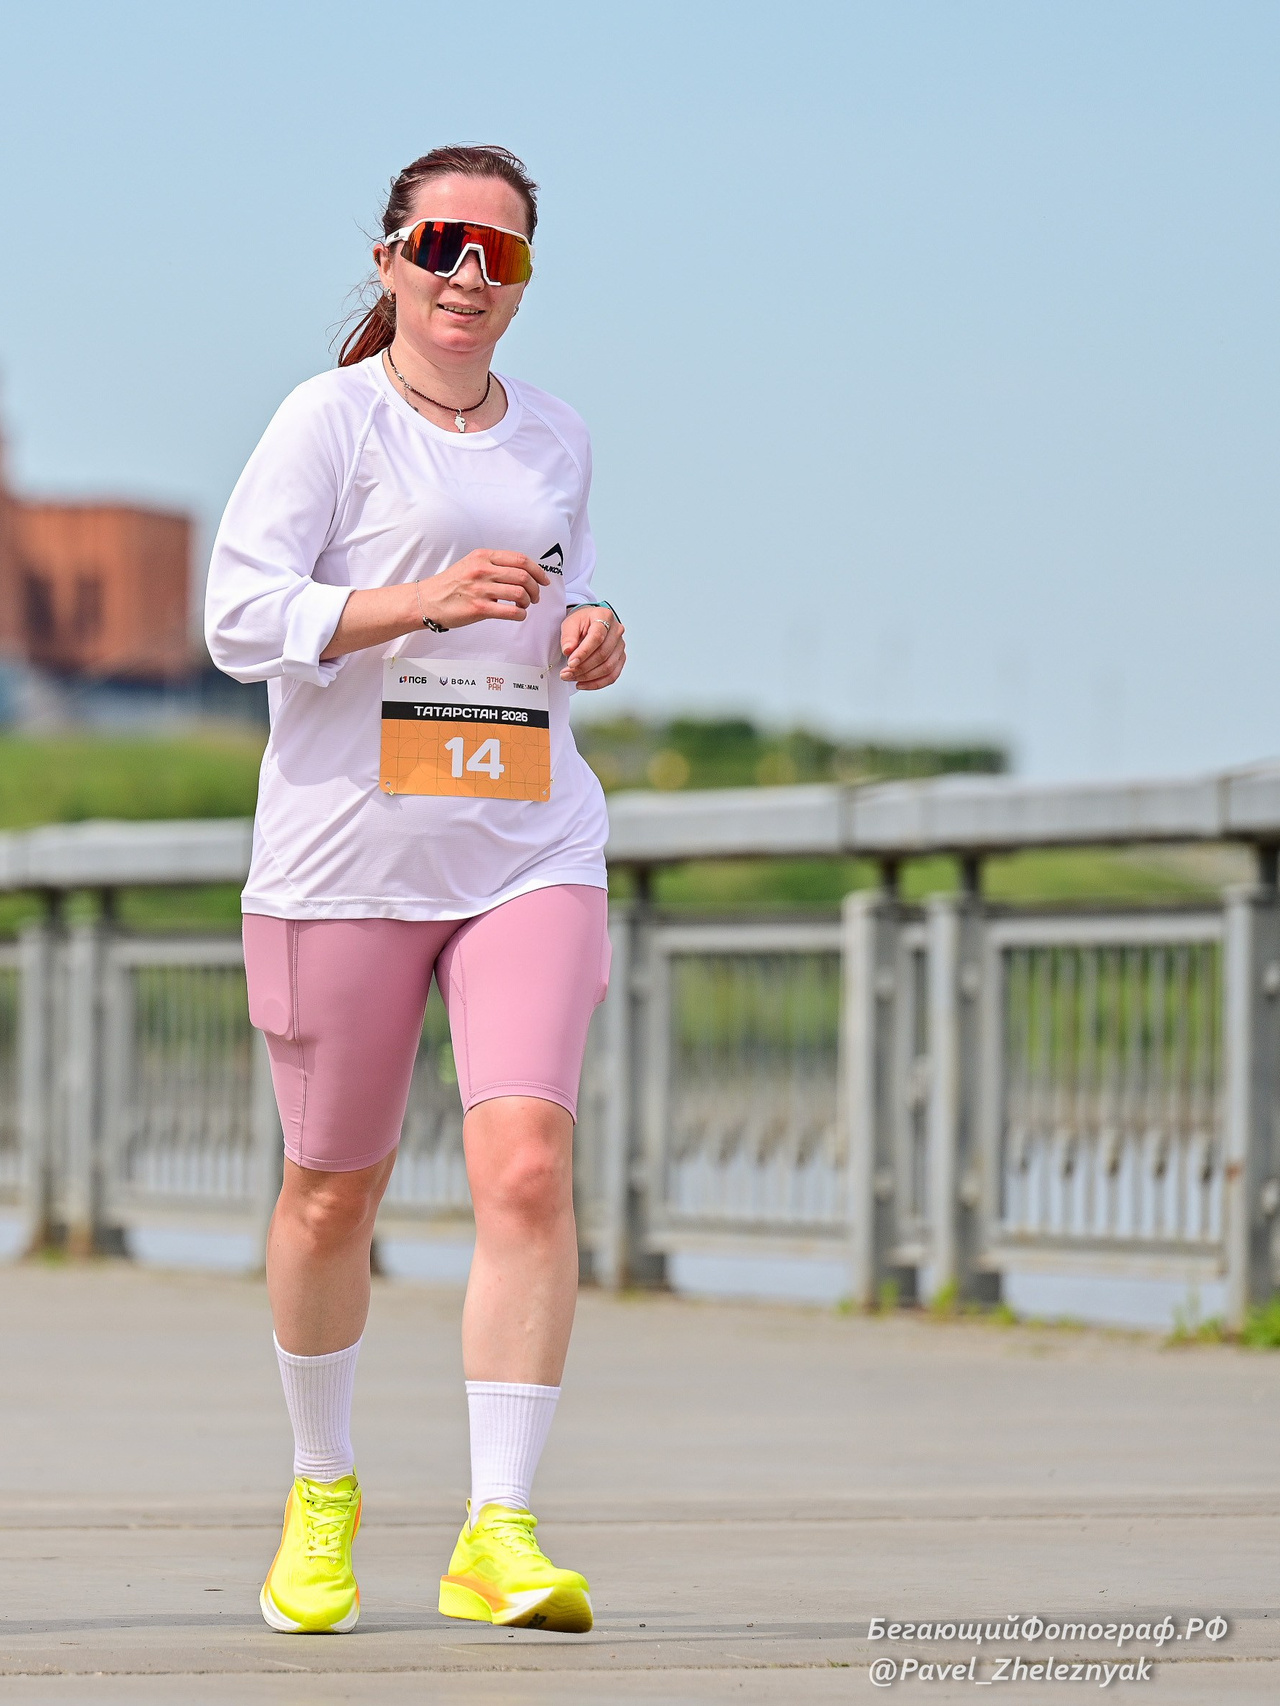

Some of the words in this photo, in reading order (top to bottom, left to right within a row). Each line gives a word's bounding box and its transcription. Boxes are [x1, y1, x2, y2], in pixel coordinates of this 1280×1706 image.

[408, 676, 427, 685] ПСБ
[451, 678, 477, 686] ВФЛА
[413, 705, 499, 720] ТАТАРСТАН
[501, 709, 529, 723] 2026
[444, 736, 505, 780] 14
